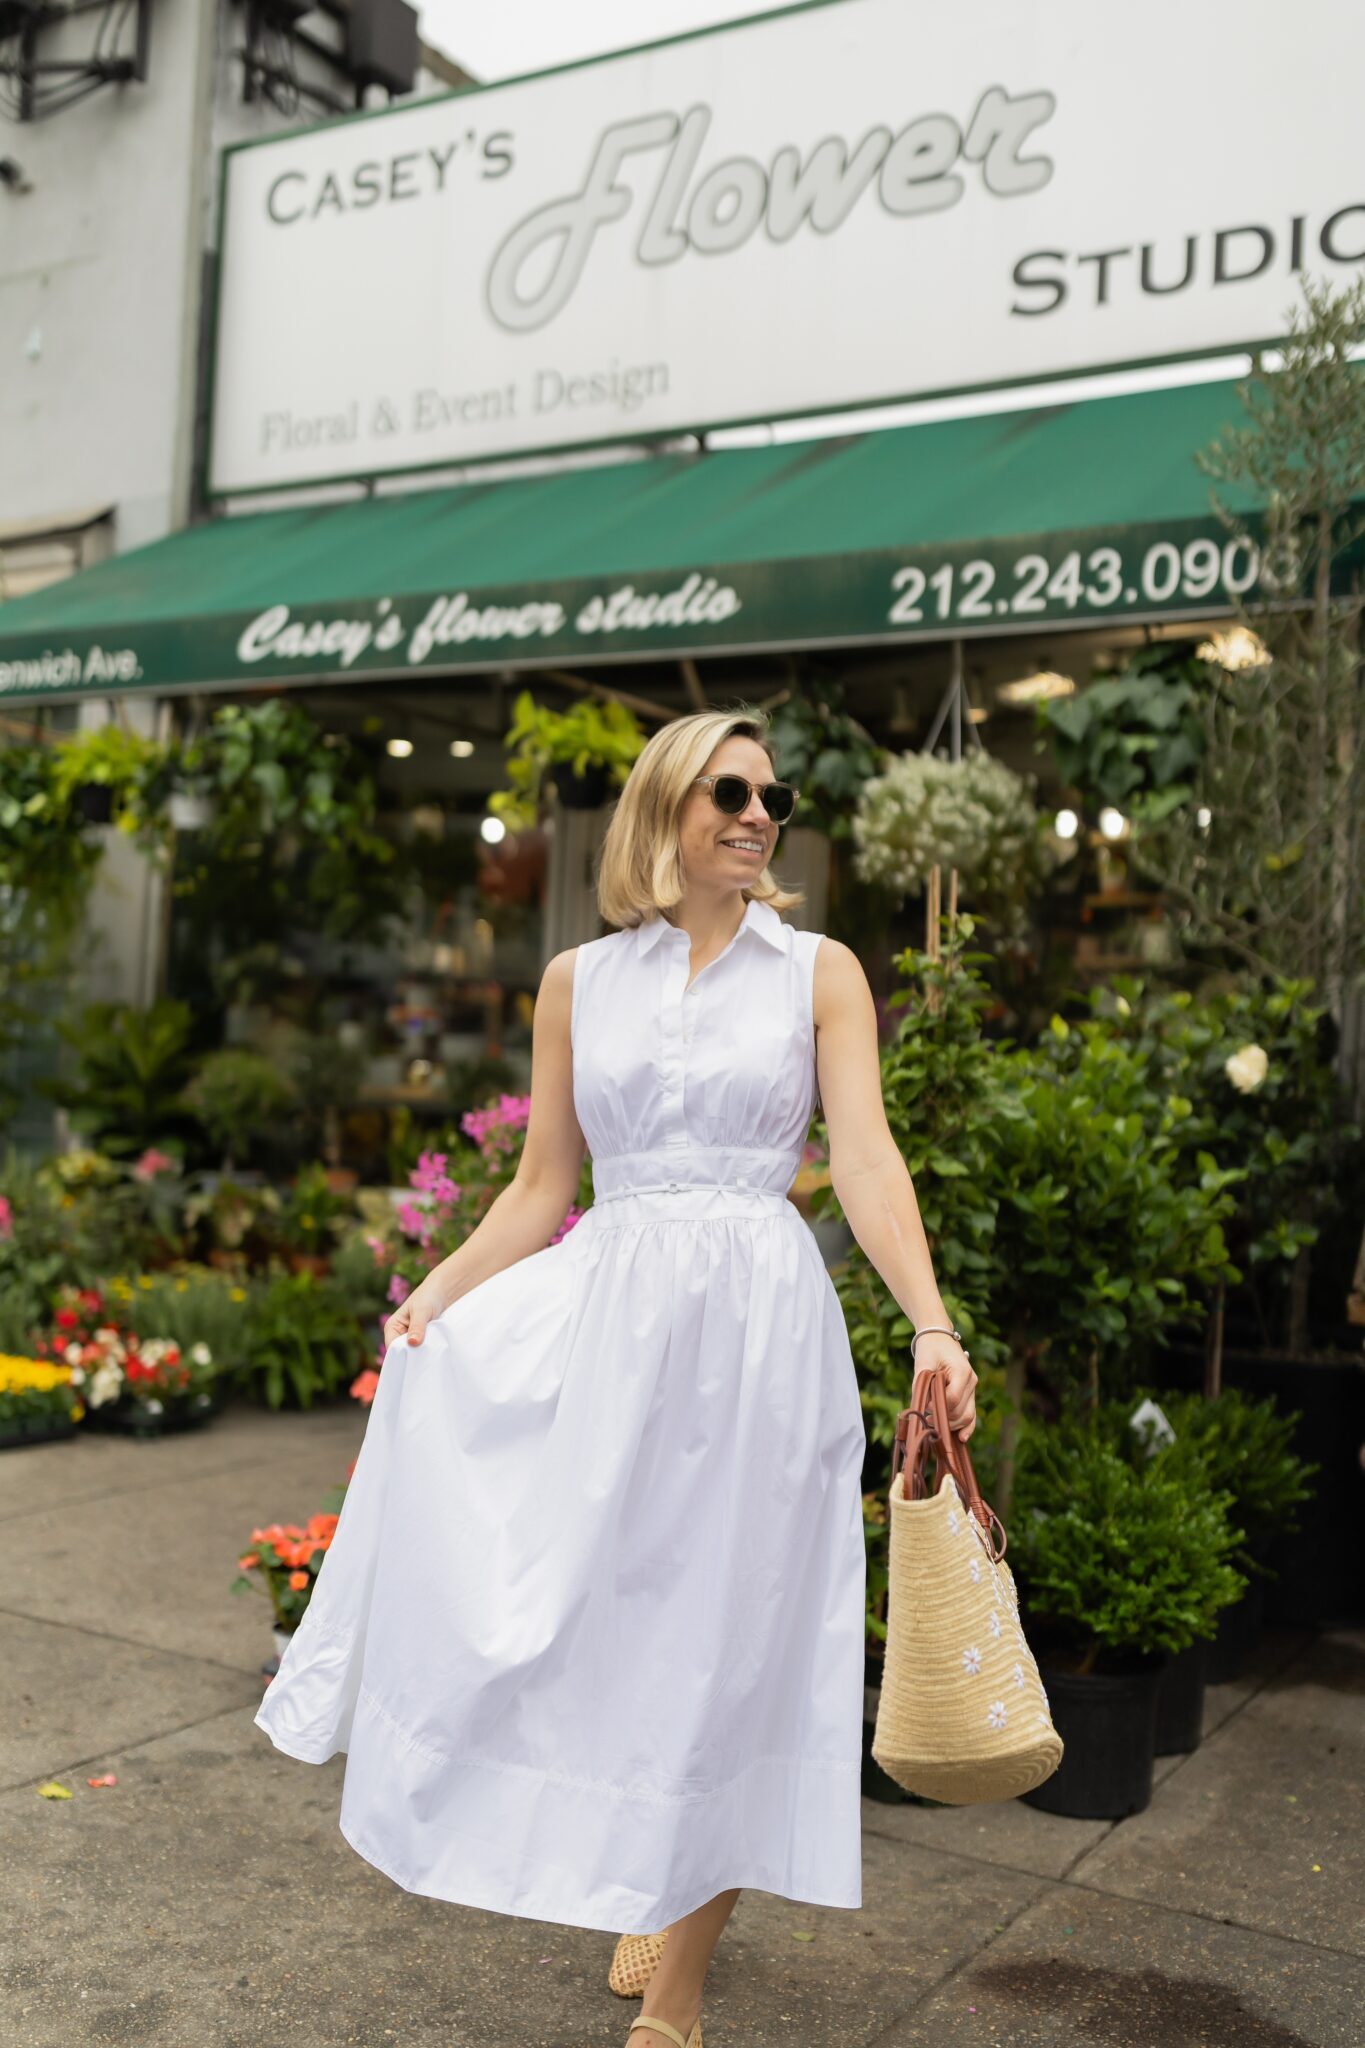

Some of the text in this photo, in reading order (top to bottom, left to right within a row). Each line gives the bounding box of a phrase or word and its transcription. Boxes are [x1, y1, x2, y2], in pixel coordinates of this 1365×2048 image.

[266, 130, 516, 227] CASEY'S
[484, 84, 1057, 335] Flower
[1010, 203, 1365, 317] STUDIO
[259, 358, 671, 456] Floral & Event Design
[82, 644, 144, 685] Ave.
[237, 572, 743, 668] Casey's flower studio
